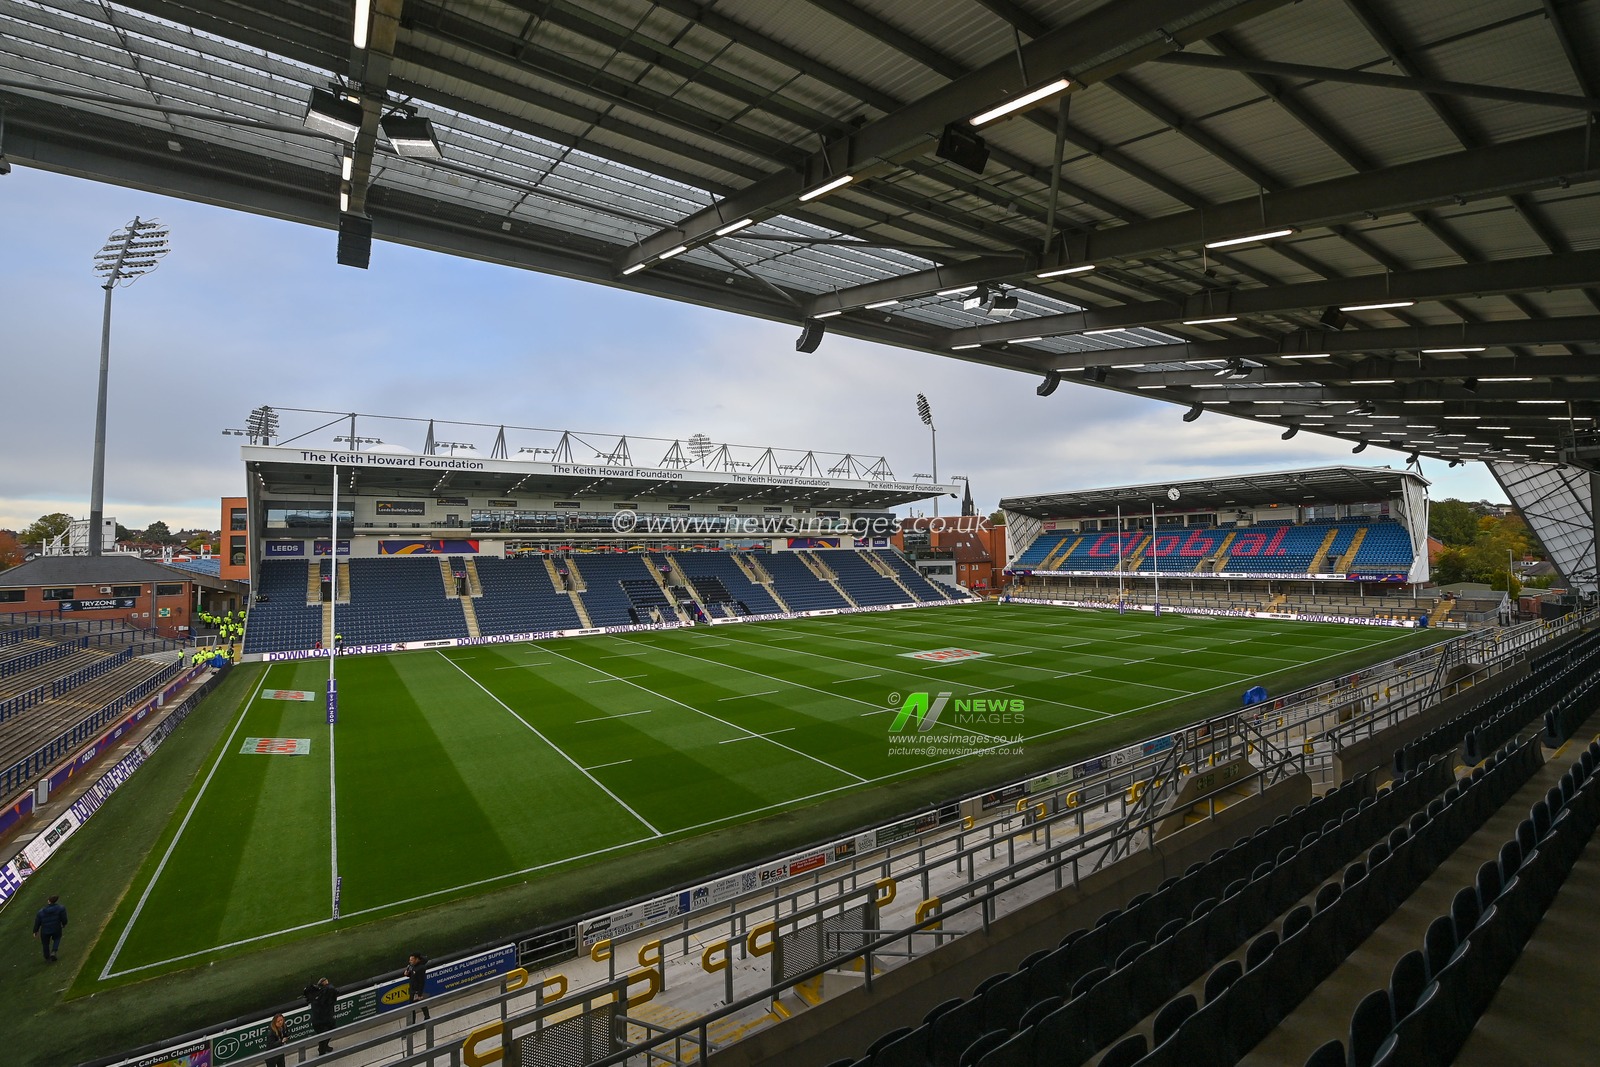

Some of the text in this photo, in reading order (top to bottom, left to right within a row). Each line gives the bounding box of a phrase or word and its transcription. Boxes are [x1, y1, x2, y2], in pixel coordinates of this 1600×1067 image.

[300, 451, 484, 469] The Keith Howard Foundation
[552, 465, 683, 479] The Keith Howard Foundation
[732, 475, 830, 486] The Keith Howard Foundation
[915, 484, 943, 492] Foundation
[1296, 614, 1346, 624] DOWNLOAD
[1349, 617, 1366, 625] FOR
[605, 625, 647, 634] DOWNLOAD
[457, 635, 510, 646] DOWNLOAD
[532, 632, 554, 640] FREE
[365, 643, 392, 653] FREE
[69, 772, 115, 825] DOWNLOAD
[693, 898, 708, 907] DJM
[426, 966, 453, 979] BUILDING
[459, 955, 487, 969] PLUMBING
[488, 948, 513, 960] SUPPLIES
[385, 988, 410, 1003] SPIN
[291, 1023, 309, 1033] USING
[139, 1043, 205, 1067] Carbon Cleaning
[217, 1041, 234, 1055] DT
